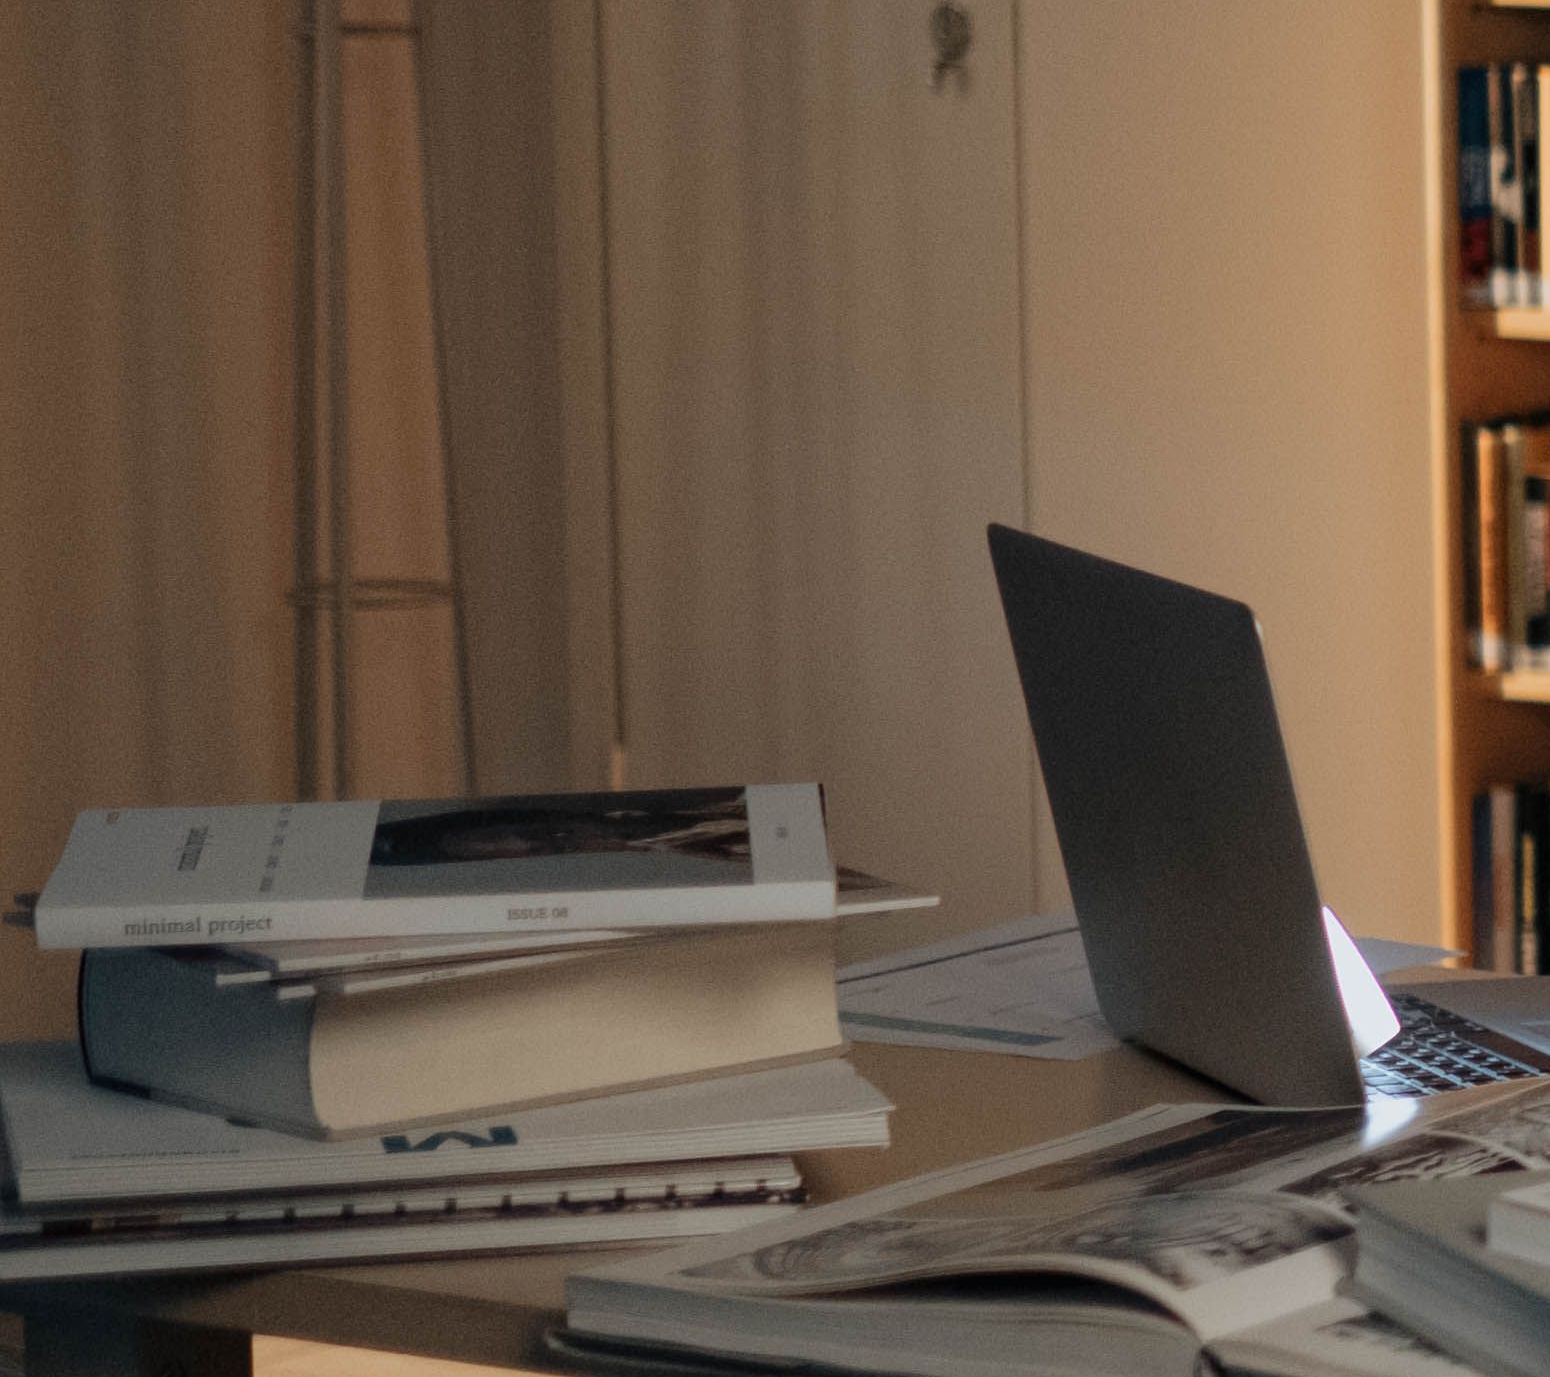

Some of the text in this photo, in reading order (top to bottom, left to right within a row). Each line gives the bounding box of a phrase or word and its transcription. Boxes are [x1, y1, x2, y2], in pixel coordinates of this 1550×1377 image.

[507, 909, 547, 920] ISSUE
[125, 916, 273, 935] minimal project
